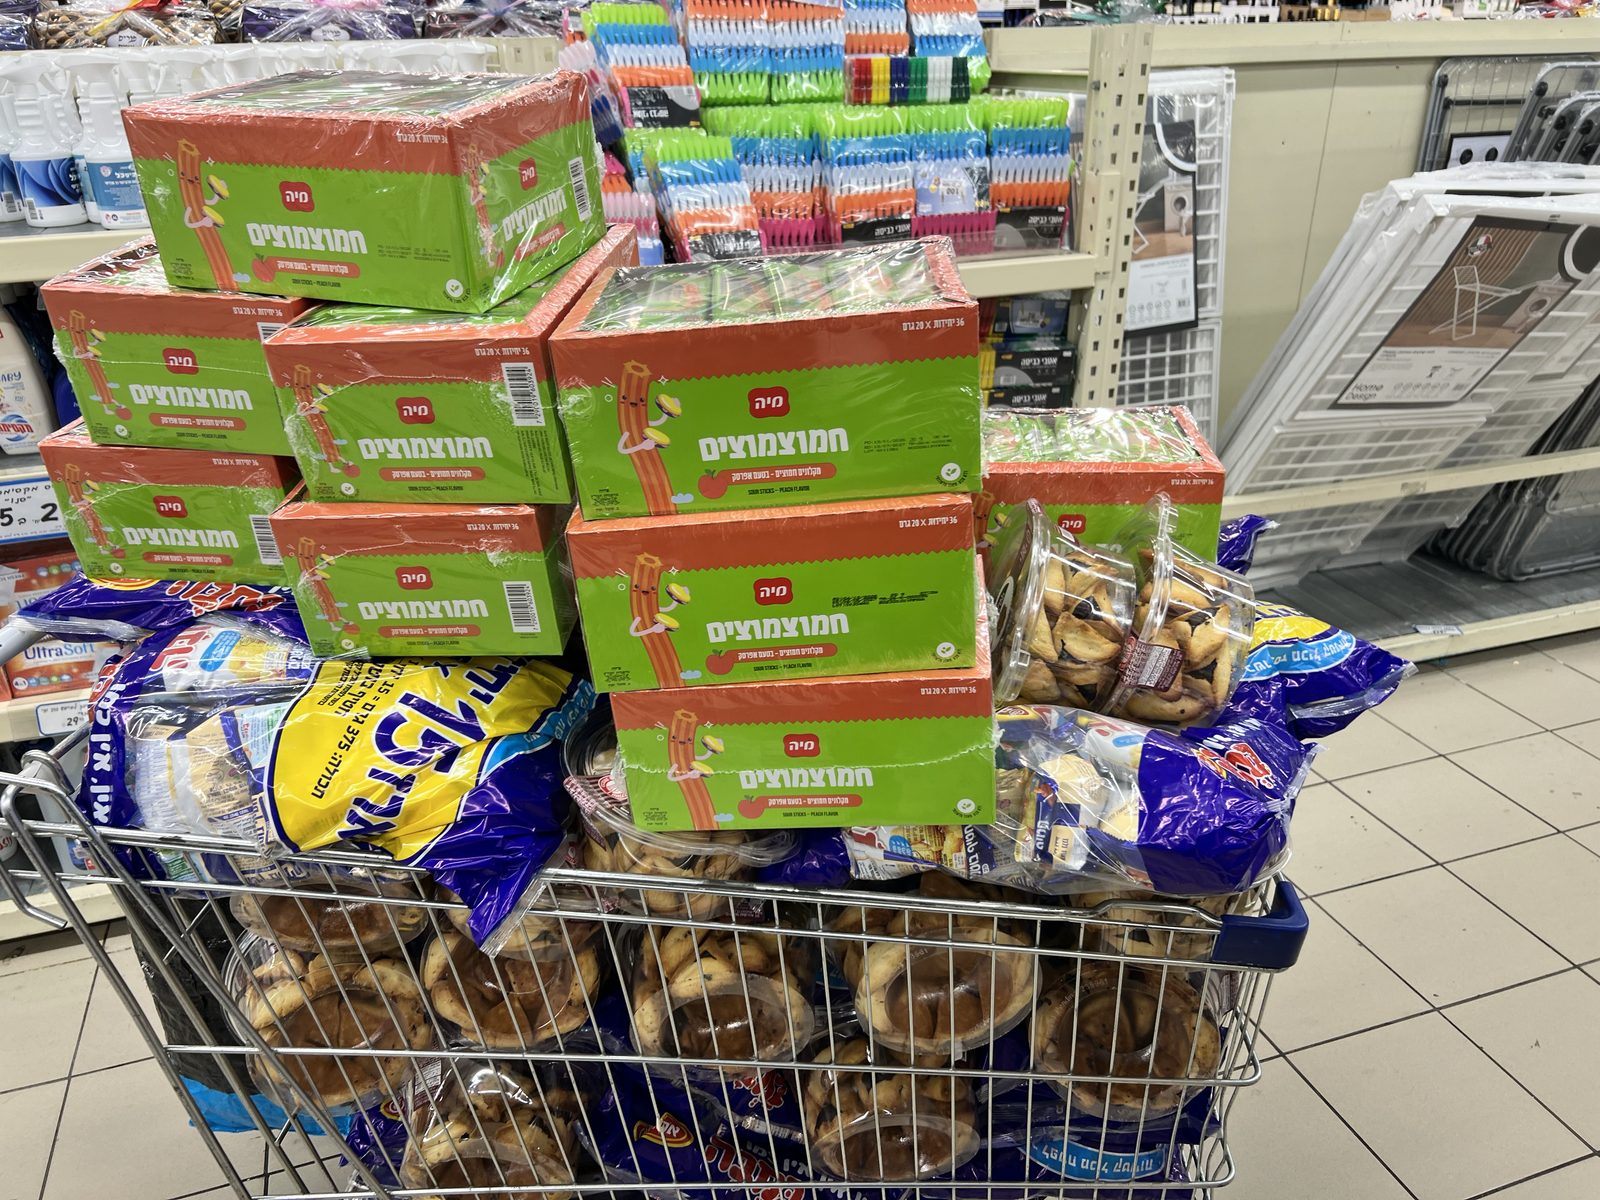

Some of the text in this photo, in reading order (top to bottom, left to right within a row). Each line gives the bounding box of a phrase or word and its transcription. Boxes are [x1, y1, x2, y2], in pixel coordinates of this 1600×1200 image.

[286, 190, 308, 203] מיה
[246, 222, 368, 254] חמוצמוצים
[902, 322, 915, 331] גרם
[916, 321, 924, 330] 20
[956, 318, 964, 326] 36
[168, 355, 192, 366] מיה
[128, 383, 253, 410] חמוצמוצים
[754, 396, 784, 410] מיה
[403, 406, 428, 416] מיה
[358, 436, 494, 460] חמוצמוצים
[698, 428, 849, 462] חמוצמוצים
[40, 502, 58, 522] 2
[159, 502, 182, 512] מיה
[1062, 518, 1082, 529] מיה
[122, 528, 240, 548] חמוצמוצים
[402, 573, 426, 584] מיה
[760, 585, 787, 598] מיה
[358, 599, 490, 620] חמוצמוצים
[706, 612, 850, 643] חמוצמוצים
[344, 725, 360, 753] 375
[377, 682, 392, 698] 15
[374, 693, 487, 773] 15
[789, 740, 815, 750] מיה
[740, 768, 874, 790] חמוצמוצים
